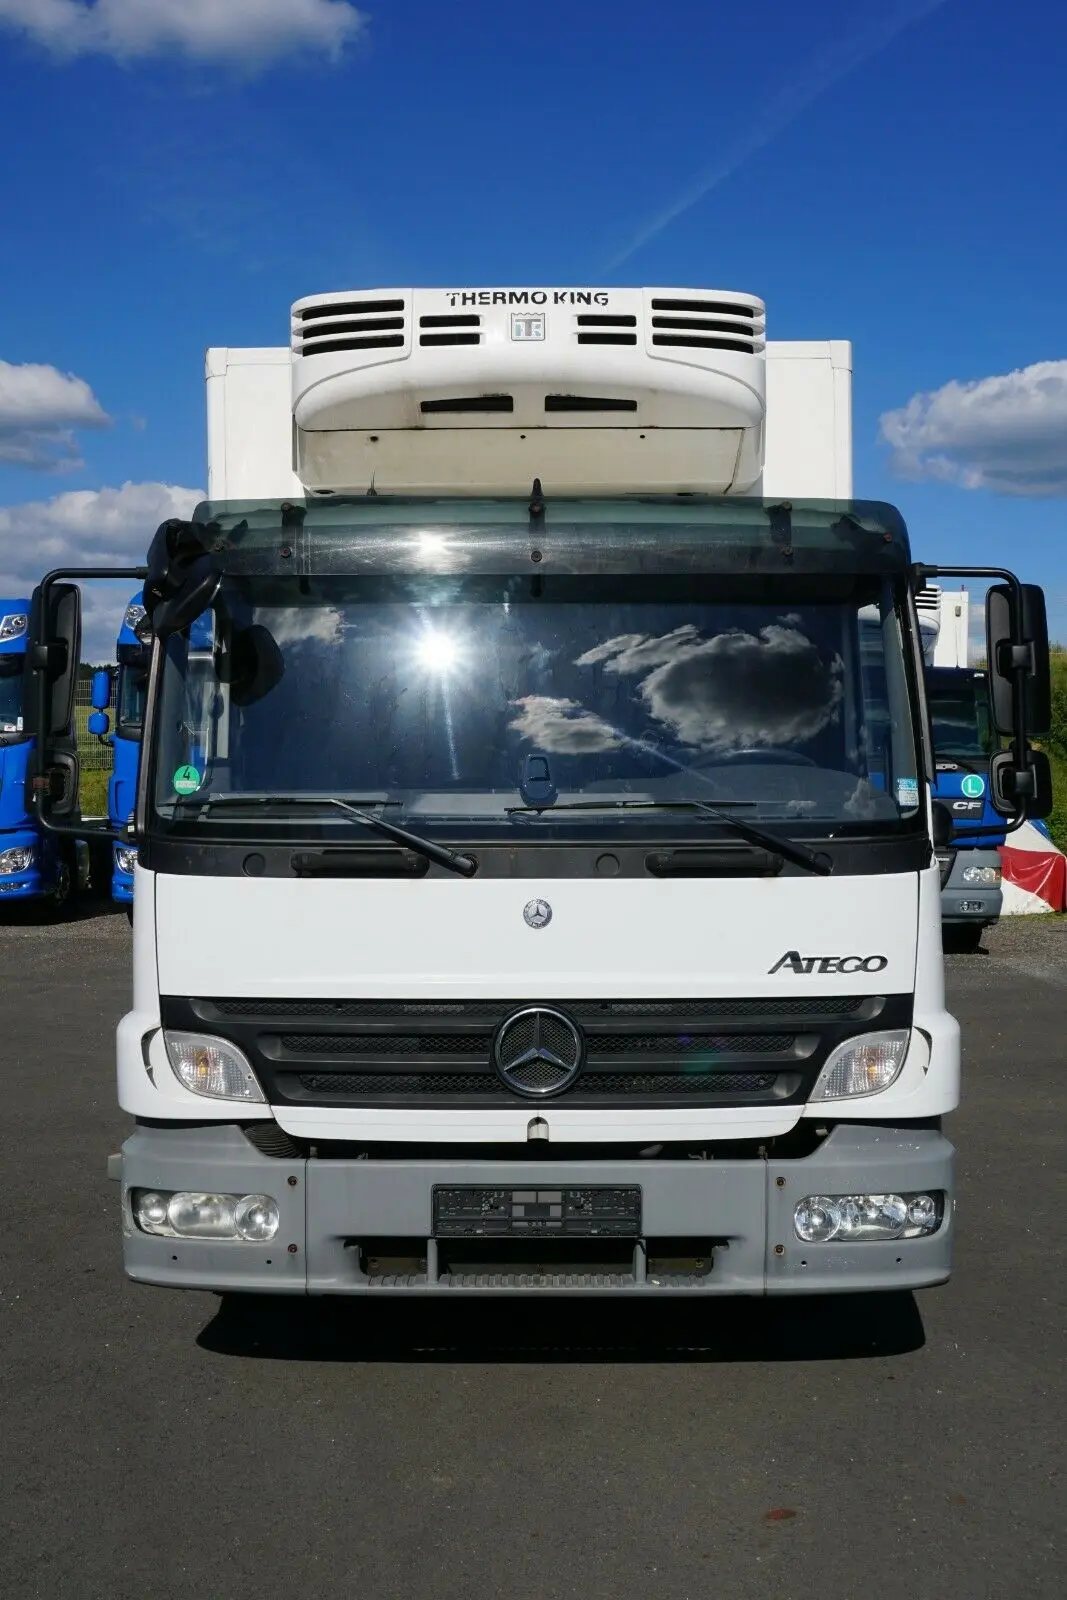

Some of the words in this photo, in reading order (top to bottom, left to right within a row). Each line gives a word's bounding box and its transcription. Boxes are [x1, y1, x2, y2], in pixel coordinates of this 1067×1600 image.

[446, 291, 548, 307] THERMO
[553, 291, 609, 306] KING
[182, 766, 191, 781] 4
[967, 778, 978, 794] L
[952, 801, 982, 810] CF
